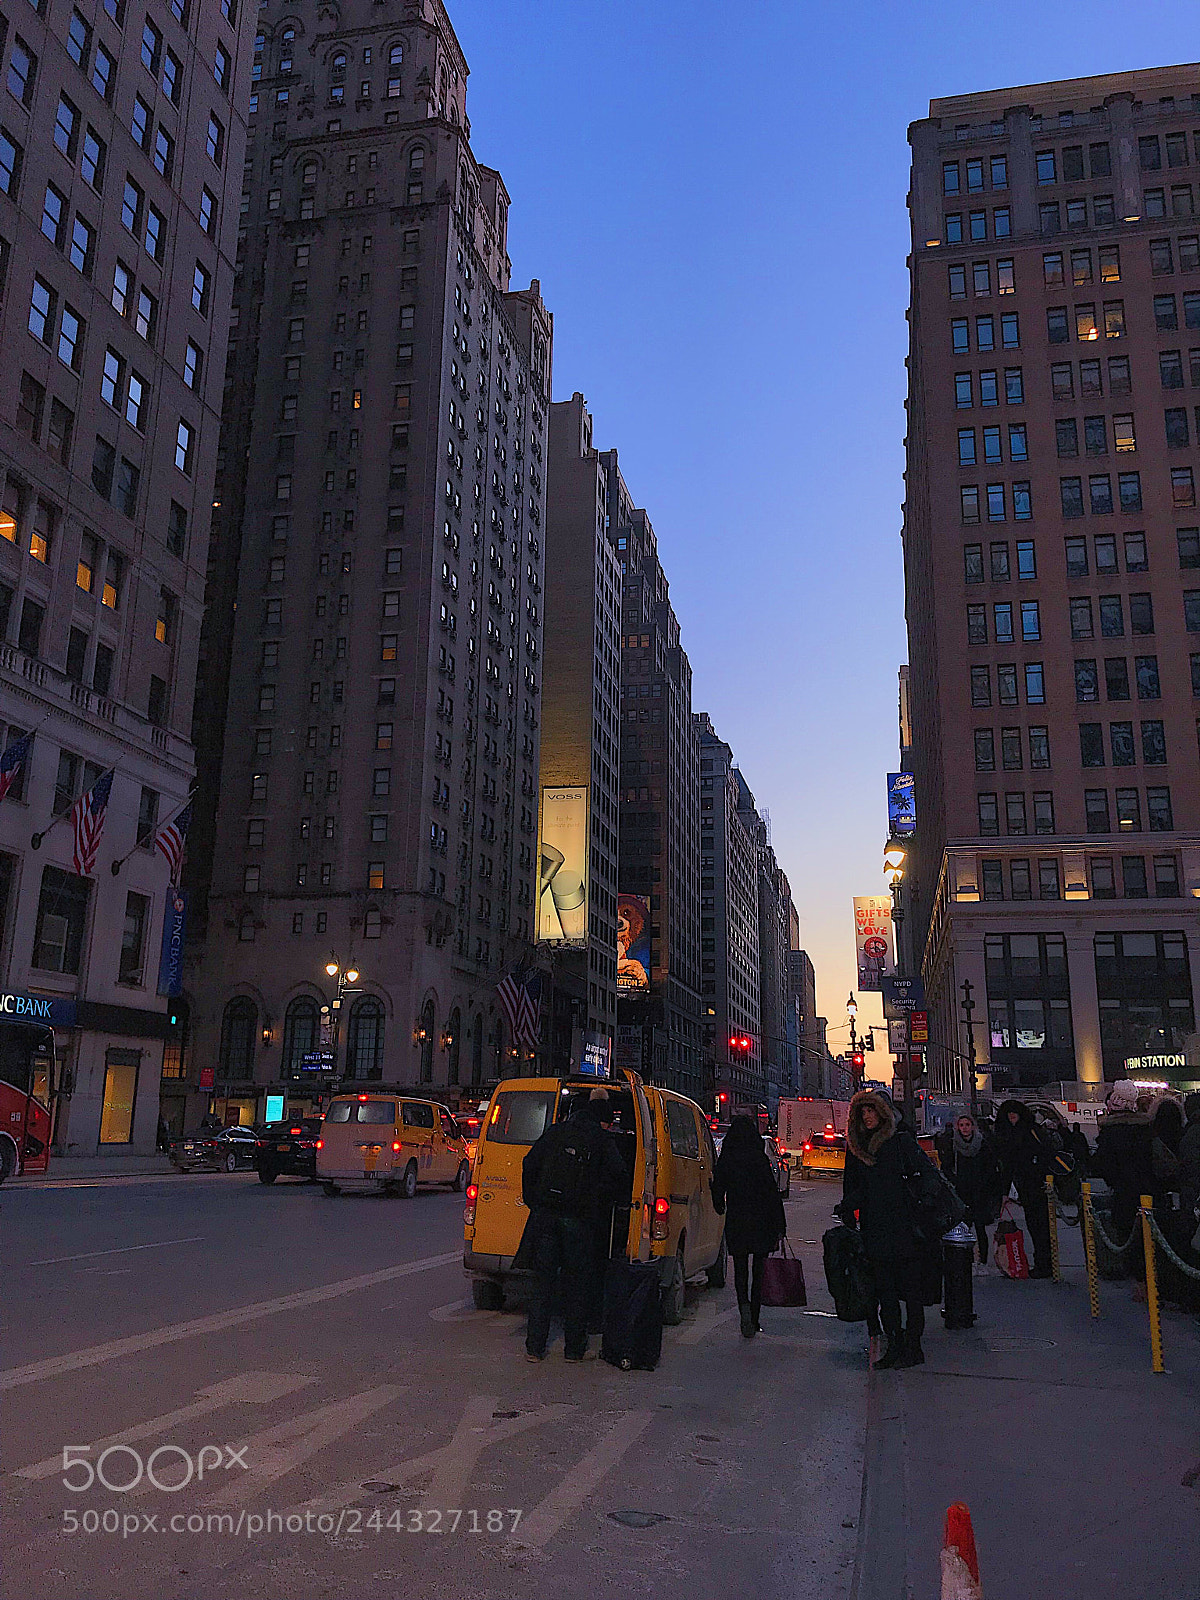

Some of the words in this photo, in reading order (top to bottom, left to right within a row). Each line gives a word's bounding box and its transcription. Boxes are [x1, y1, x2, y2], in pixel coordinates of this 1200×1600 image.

[856, 909, 890, 918] GIFTS
[857, 918, 875, 926] WE
[857, 927, 888, 935] LOVE
[638, 979, 644, 987] 2
[891, 998, 916, 1006] Security
[1126, 1057, 1141, 1070] PENN
[1141, 1054, 1186, 1068] STATION
